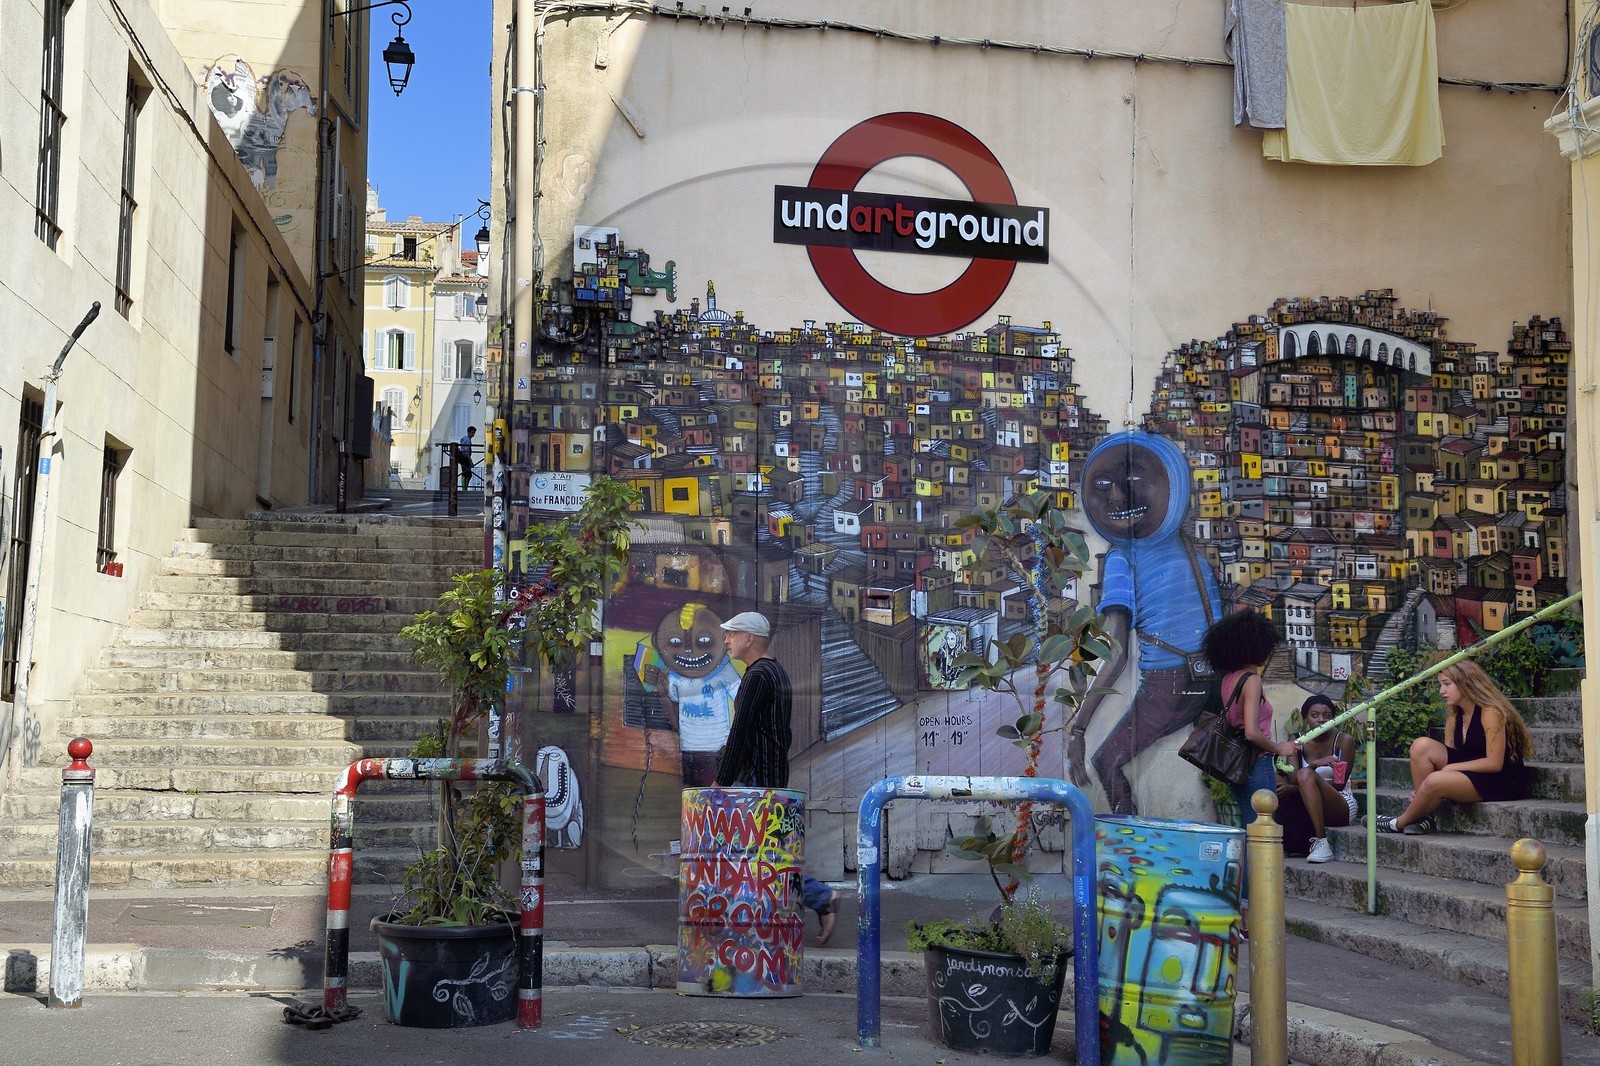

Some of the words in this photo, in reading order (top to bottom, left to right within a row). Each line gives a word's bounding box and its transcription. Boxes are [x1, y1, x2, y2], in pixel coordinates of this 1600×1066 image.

[781, 193, 1044, 249] undartground
[531, 496, 542, 504] Ste
[919, 717, 940, 726] OPEN
[944, 716, 973, 726] HOURS
